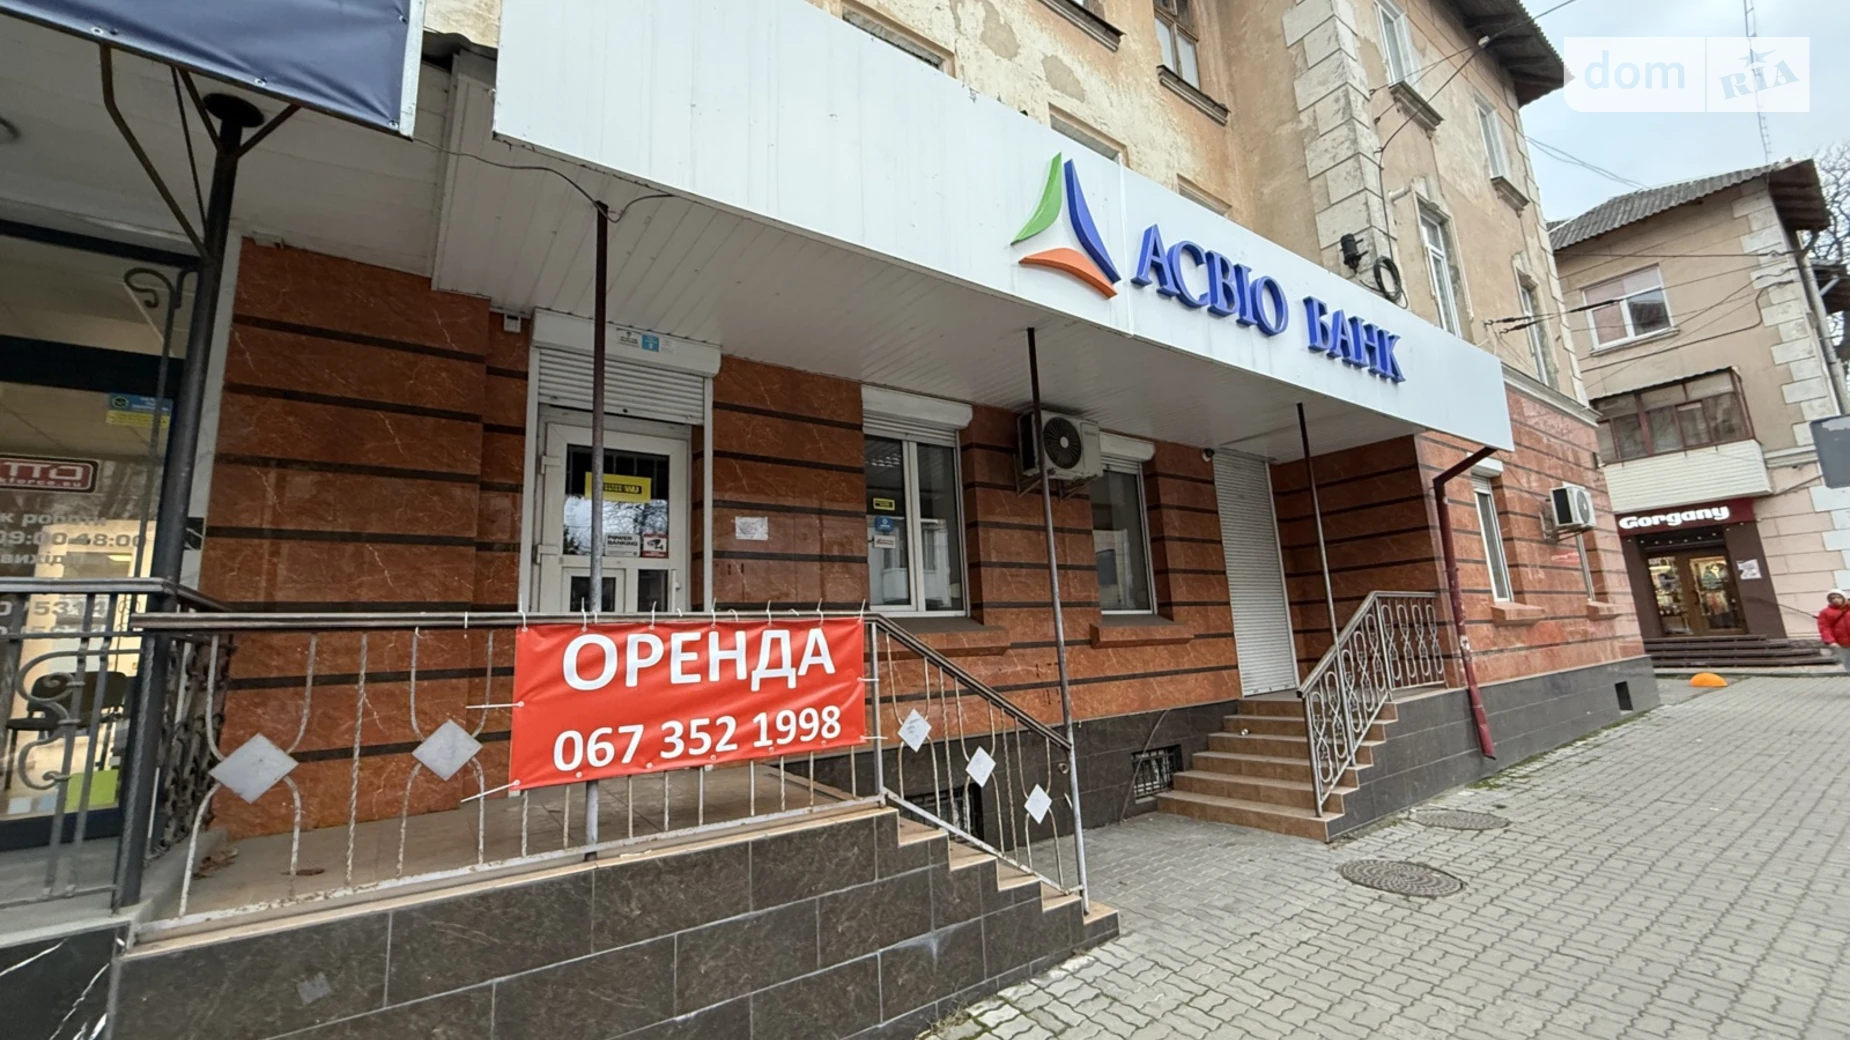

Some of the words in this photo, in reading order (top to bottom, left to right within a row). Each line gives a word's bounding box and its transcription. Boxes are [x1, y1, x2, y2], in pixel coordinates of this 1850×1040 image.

[1130, 223, 1289, 336] АСВІО
[1303, 296, 1406, 383] БАНК
[1619, 506, 1730, 529] Gorgany
[562, 628, 835, 691] ОРЕНДА
[554, 724, 644, 772] 067
[660, 715, 738, 759] 352
[753, 705, 841, 748] 1998
